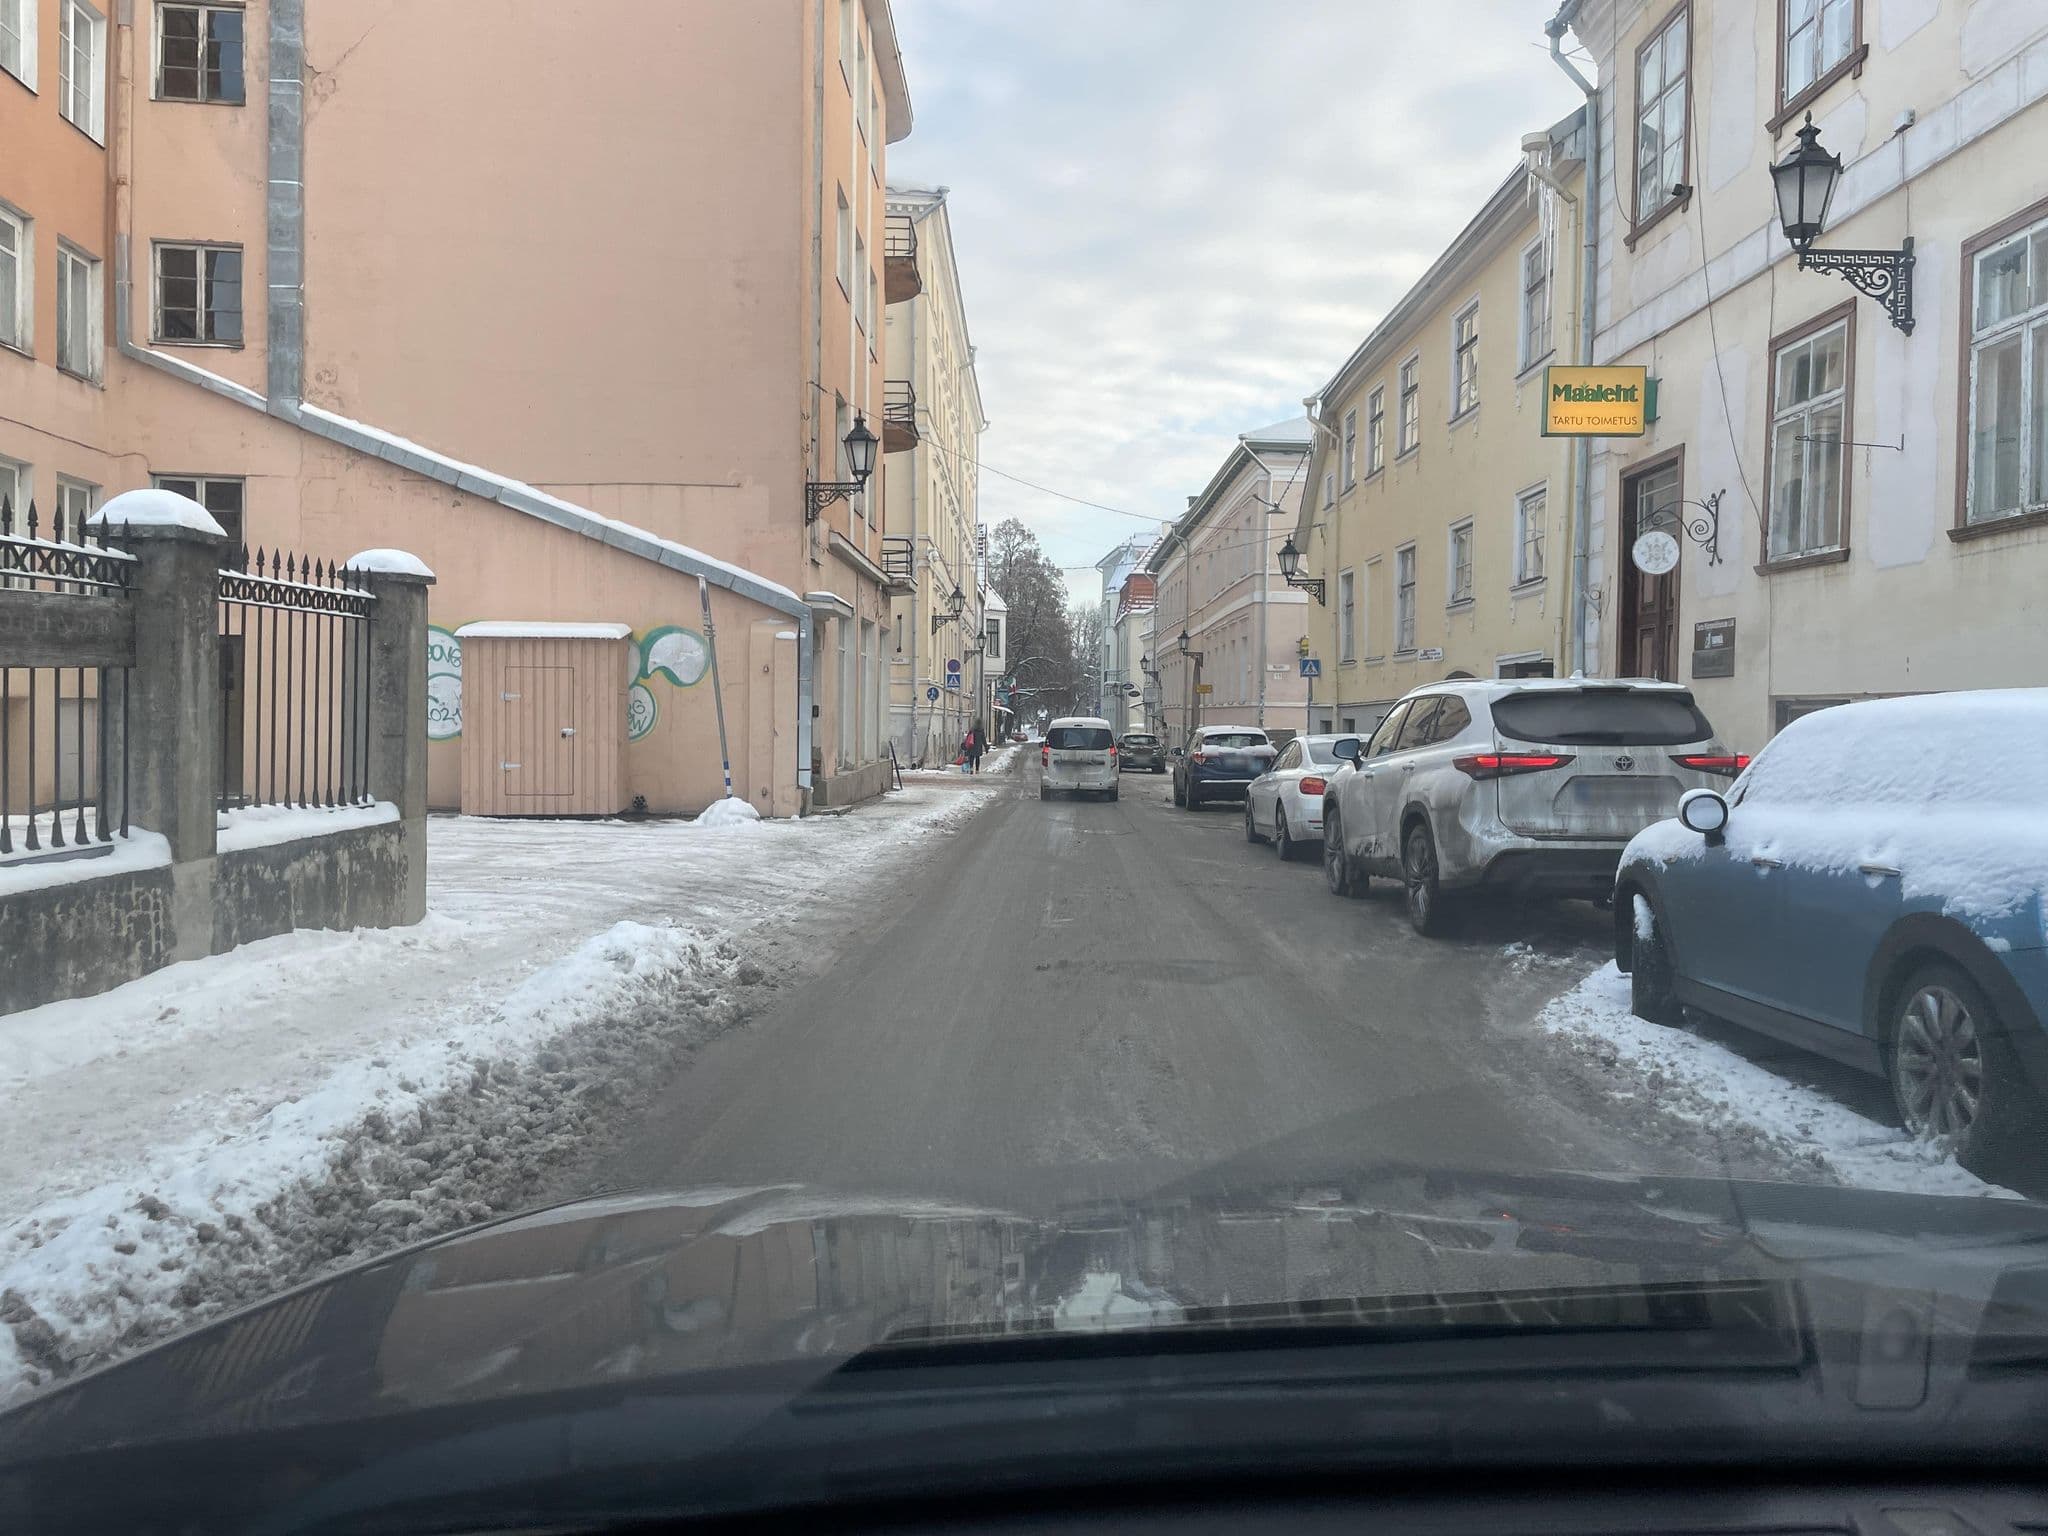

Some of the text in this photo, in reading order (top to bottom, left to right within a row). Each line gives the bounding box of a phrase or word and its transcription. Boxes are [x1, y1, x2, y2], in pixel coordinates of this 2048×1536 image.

[1553, 383, 1638, 402] Maaleht
[1553, 415, 1638, 426] TARTU TOIMETUS
[428, 707, 462, 725] 021
